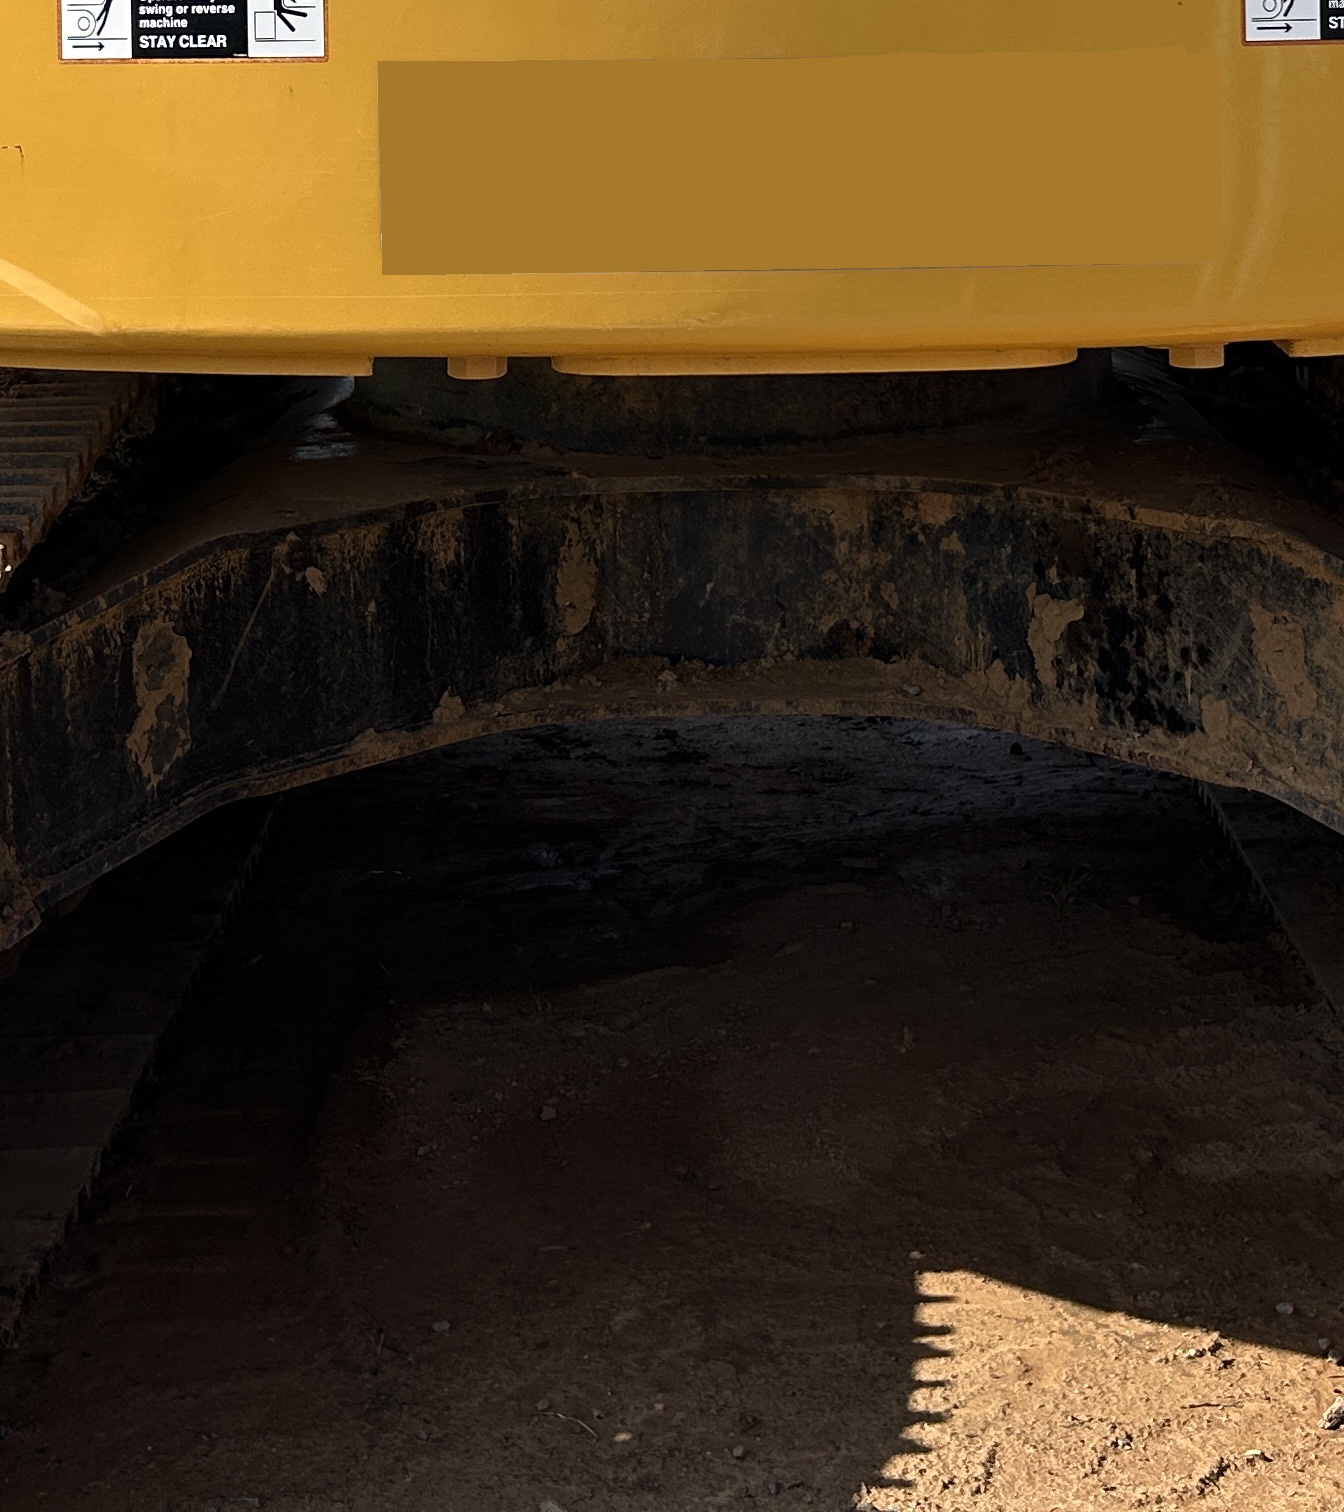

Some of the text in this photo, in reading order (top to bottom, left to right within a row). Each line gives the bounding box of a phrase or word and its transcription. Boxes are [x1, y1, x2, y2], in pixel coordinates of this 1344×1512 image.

[138, 4, 236, 16] swing or reverse
[139, 18, 188, 29] machine
[139, 35, 227, 49] STAY CLEAR
